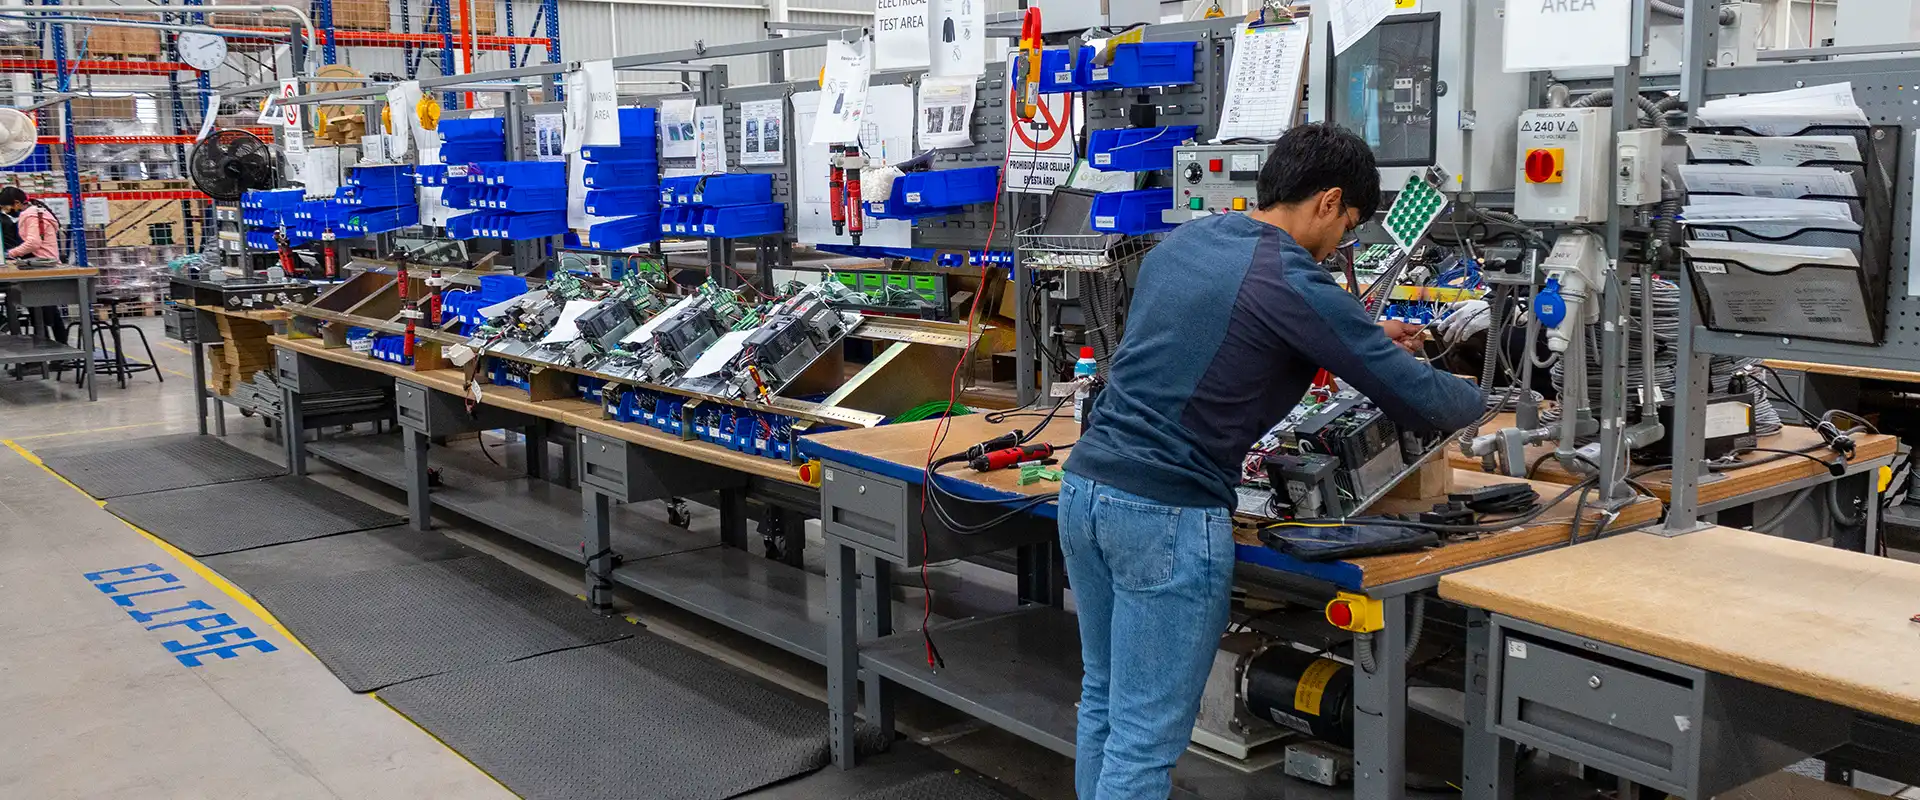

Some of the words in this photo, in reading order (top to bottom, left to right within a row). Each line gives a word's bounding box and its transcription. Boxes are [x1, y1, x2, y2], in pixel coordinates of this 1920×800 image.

[878, 0, 926, 8] ELECTR
[1540, 0, 1596, 13] AREA
[879, 18, 898, 31] TEST
[900, 15, 924, 29] AREA
[590, 92, 612, 102] WIRING
[594, 110, 610, 120] AREA
[1535, 121, 1554, 131] 240
[1557, 121, 1565, 131] V
[1010, 160, 1035, 170] PROHIBIDO
[1036, 162, 1049, 171] USAR
[1050, 163, 1070, 172] CELULAR
[1031, 176, 1042, 185] ESTA
[1043, 174, 1055, 185] ÁREA
[83, 563, 279, 668] ECLIPSE
